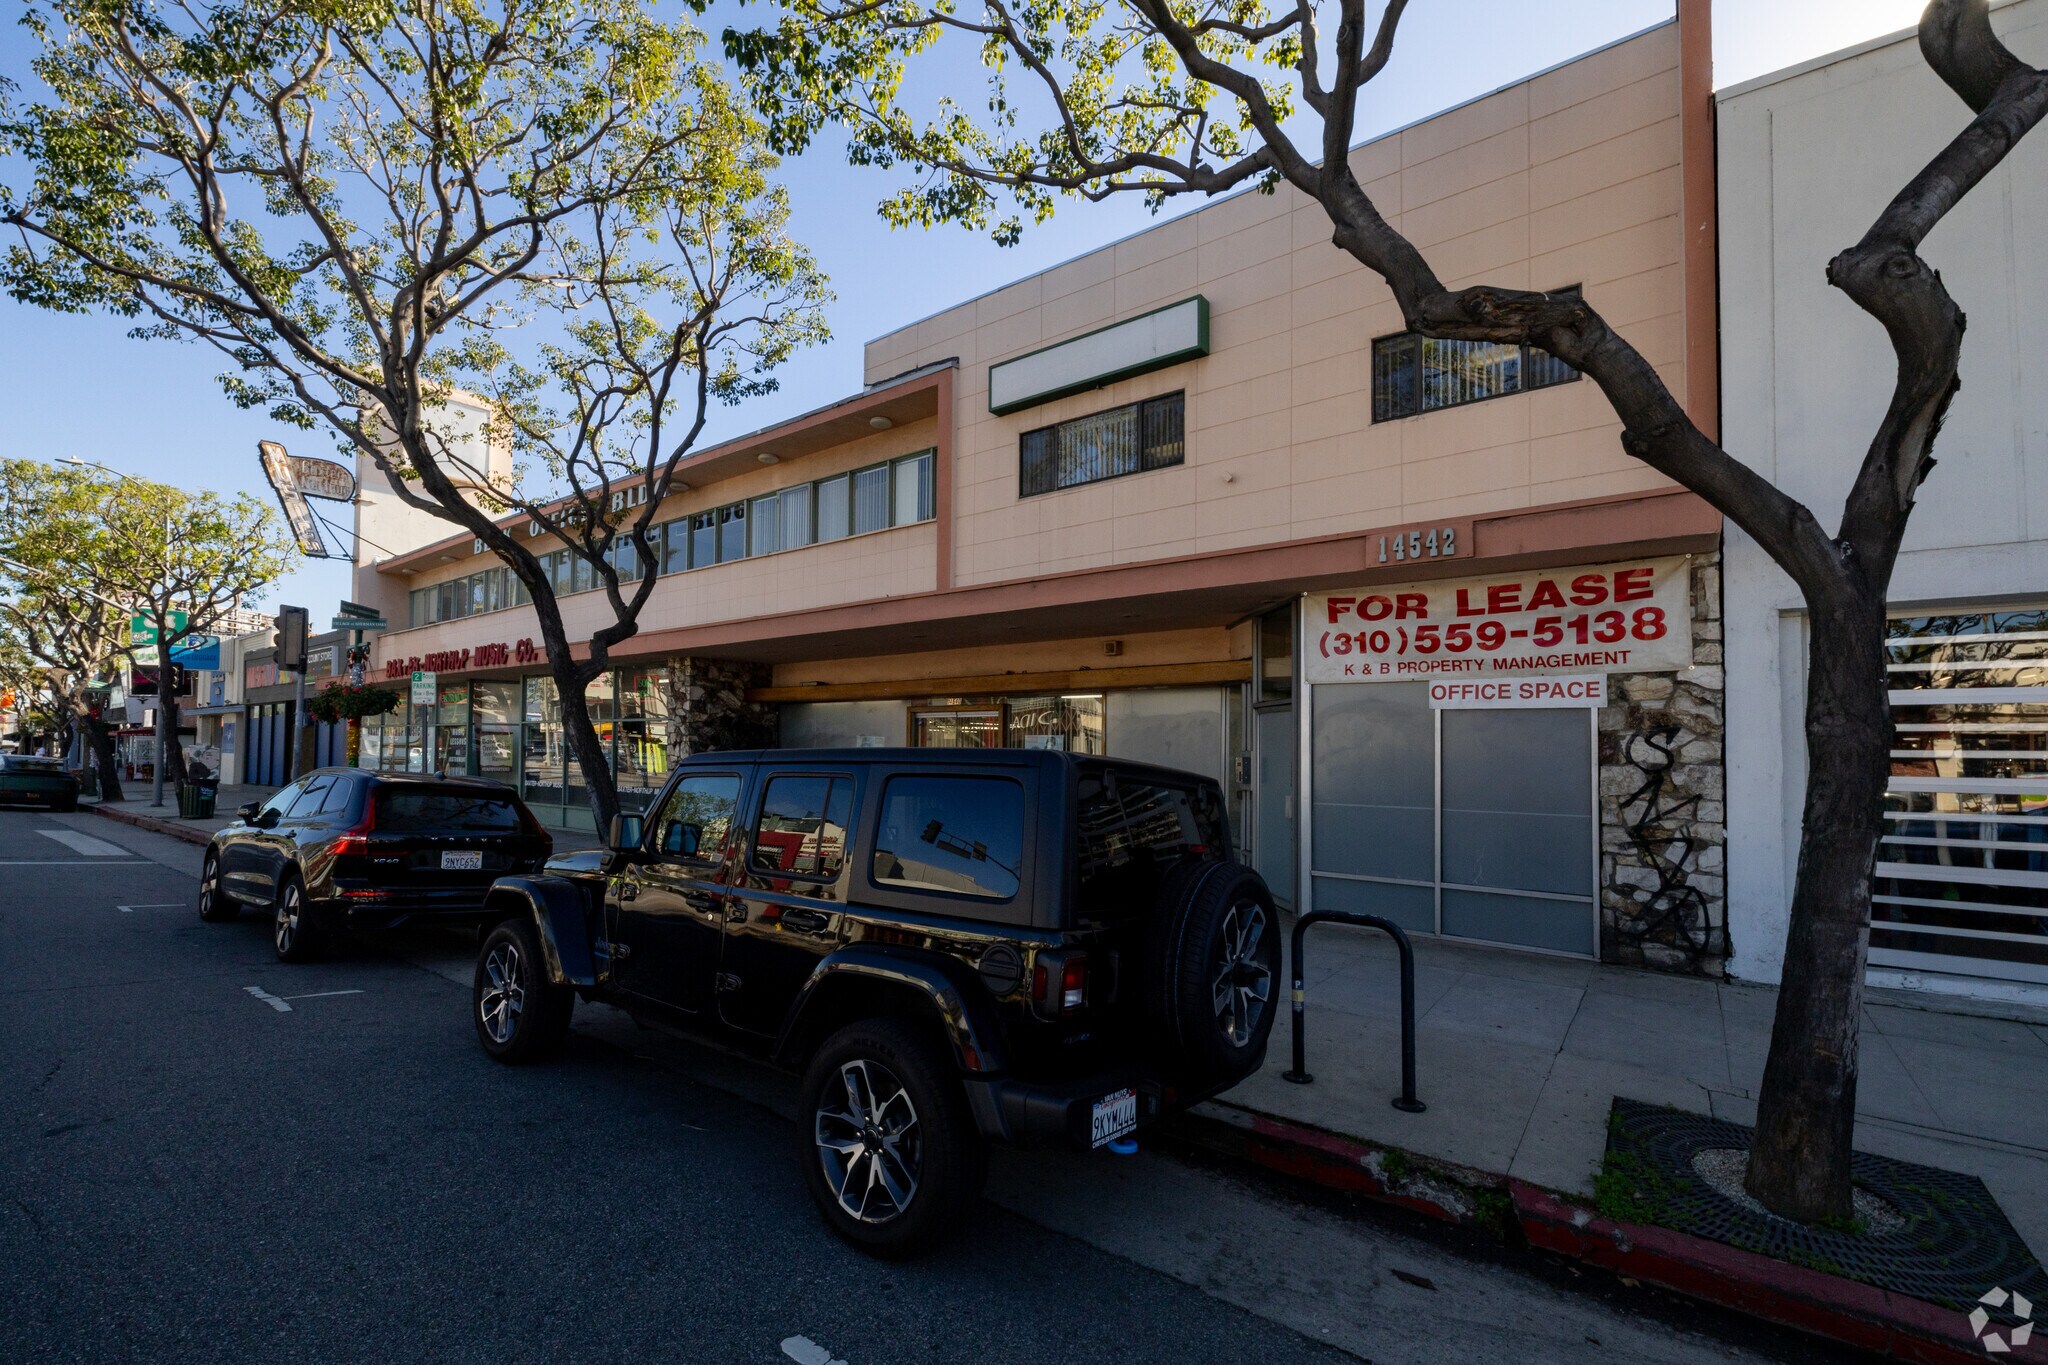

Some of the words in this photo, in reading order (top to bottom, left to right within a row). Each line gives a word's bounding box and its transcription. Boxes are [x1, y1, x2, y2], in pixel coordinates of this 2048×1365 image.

[1378, 527, 1456, 563] 14542
[1327, 592, 1430, 624] FOR
[1456, 567, 1655, 618] LEASE
[1319, 606, 1668, 659] (310)559-5138
[386, 648, 470, 679] BAXER-NORTHUP
[474, 642, 509, 667] MUSIC
[515, 637, 539, 663] CO.
[1344, 664, 1356, 676] K
[1362, 663, 1372, 675] &
[1380, 662, 1390, 674] B
[1397, 657, 1485, 675] PROPERTY
[1493, 650, 1631, 671] MANAGEMENT
[414, 673, 420, 681] 2
[1431, 683, 1512, 702] OFFICE
[1519, 680, 1602, 700] SPACE
[1295, 980, 1301, 989] P
[1093, 1102, 1136, 1140] 9KYM444
